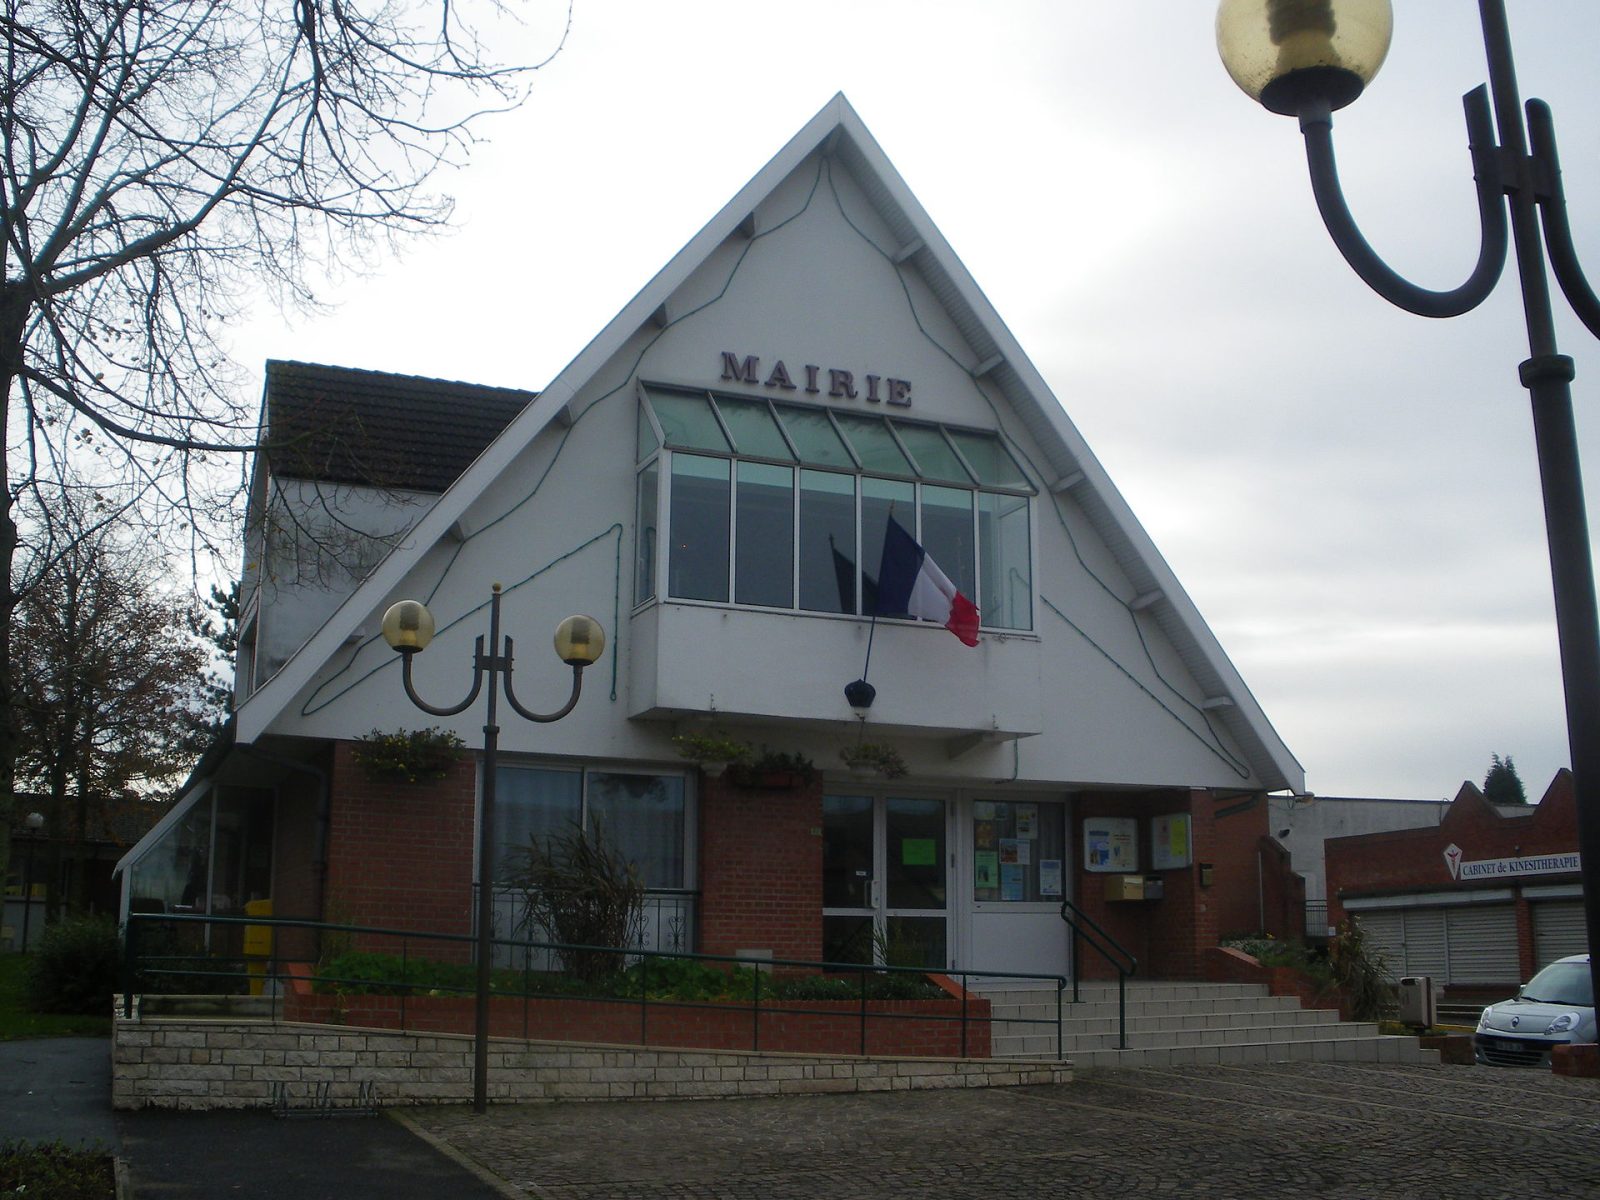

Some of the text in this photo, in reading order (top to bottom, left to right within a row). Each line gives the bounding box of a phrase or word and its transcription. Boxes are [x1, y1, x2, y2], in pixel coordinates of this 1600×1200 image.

[721, 351, 912, 408] MAIRIE
[1462, 856, 1578, 876] CABINET de KINESITHERAPIE
